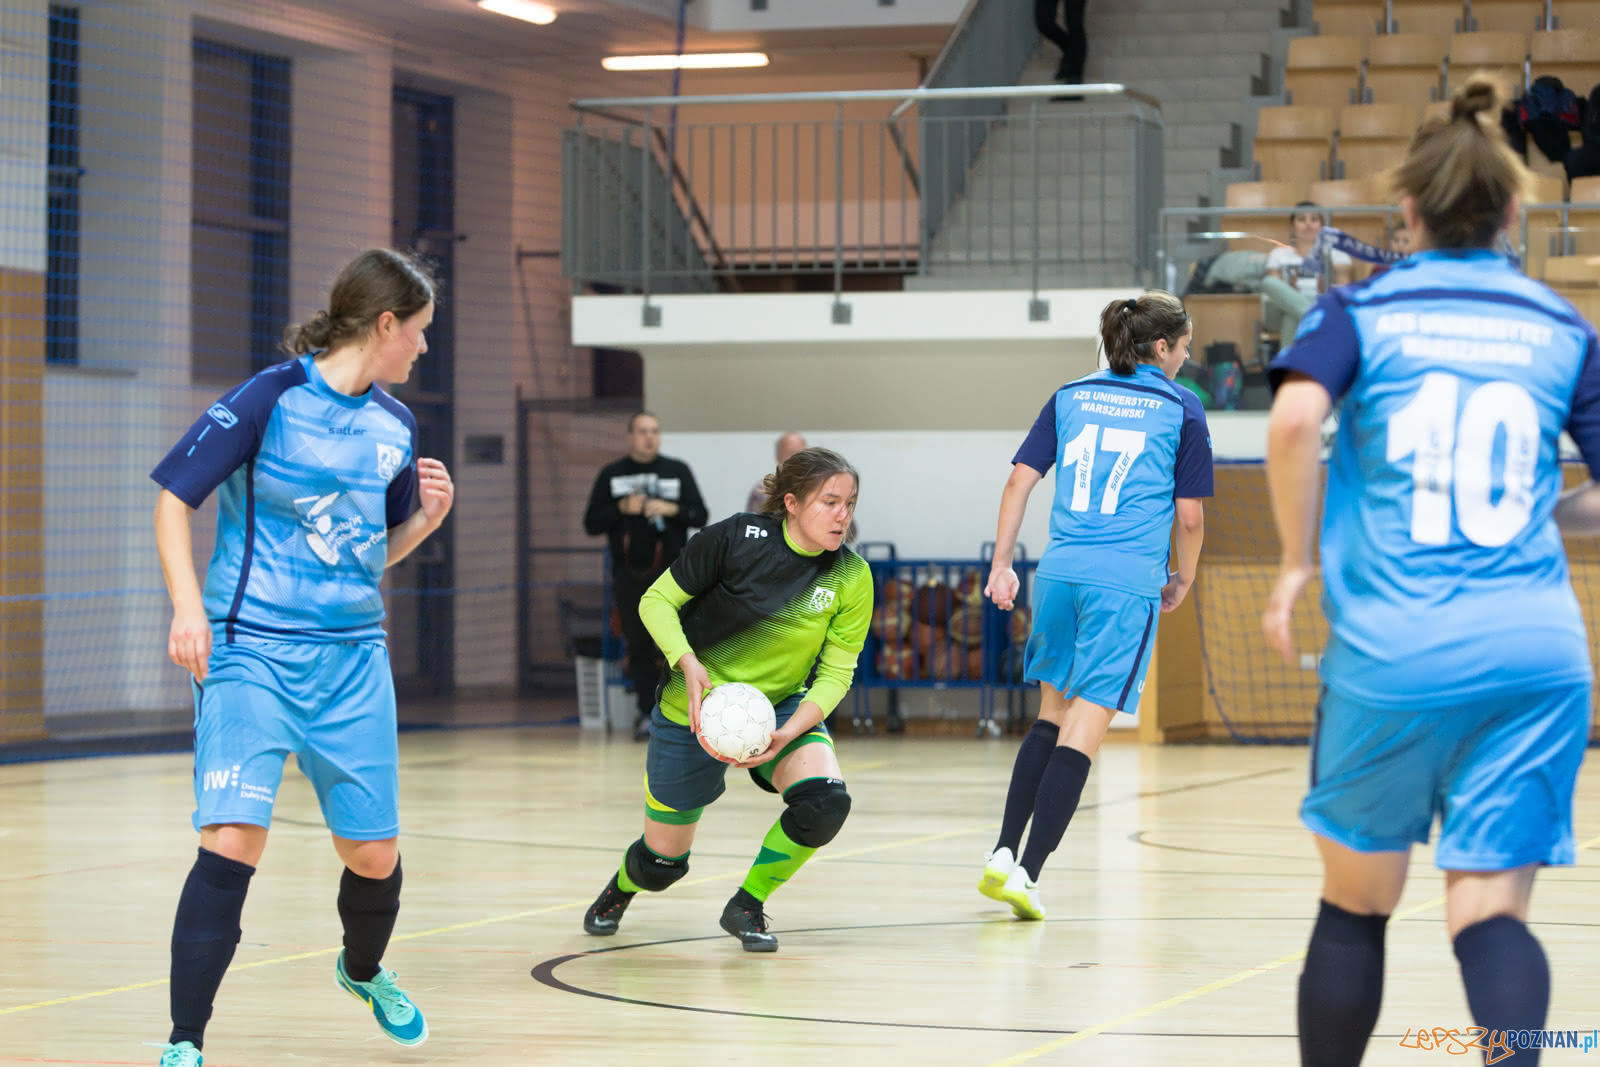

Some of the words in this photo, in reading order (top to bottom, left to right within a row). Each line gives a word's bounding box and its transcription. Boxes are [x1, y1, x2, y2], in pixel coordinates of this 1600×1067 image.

[1072, 390, 1091, 401] AZS
[1092, 391, 1163, 410] UNIWERSYTET
[1080, 402, 1146, 419] WARSZAWSKI
[1063, 423, 1147, 515] 17
[1079, 448, 1091, 489] saller
[1111, 451, 1131, 491] saller
[1386, 372, 1540, 547] 10
[203, 768, 230, 792] UW
